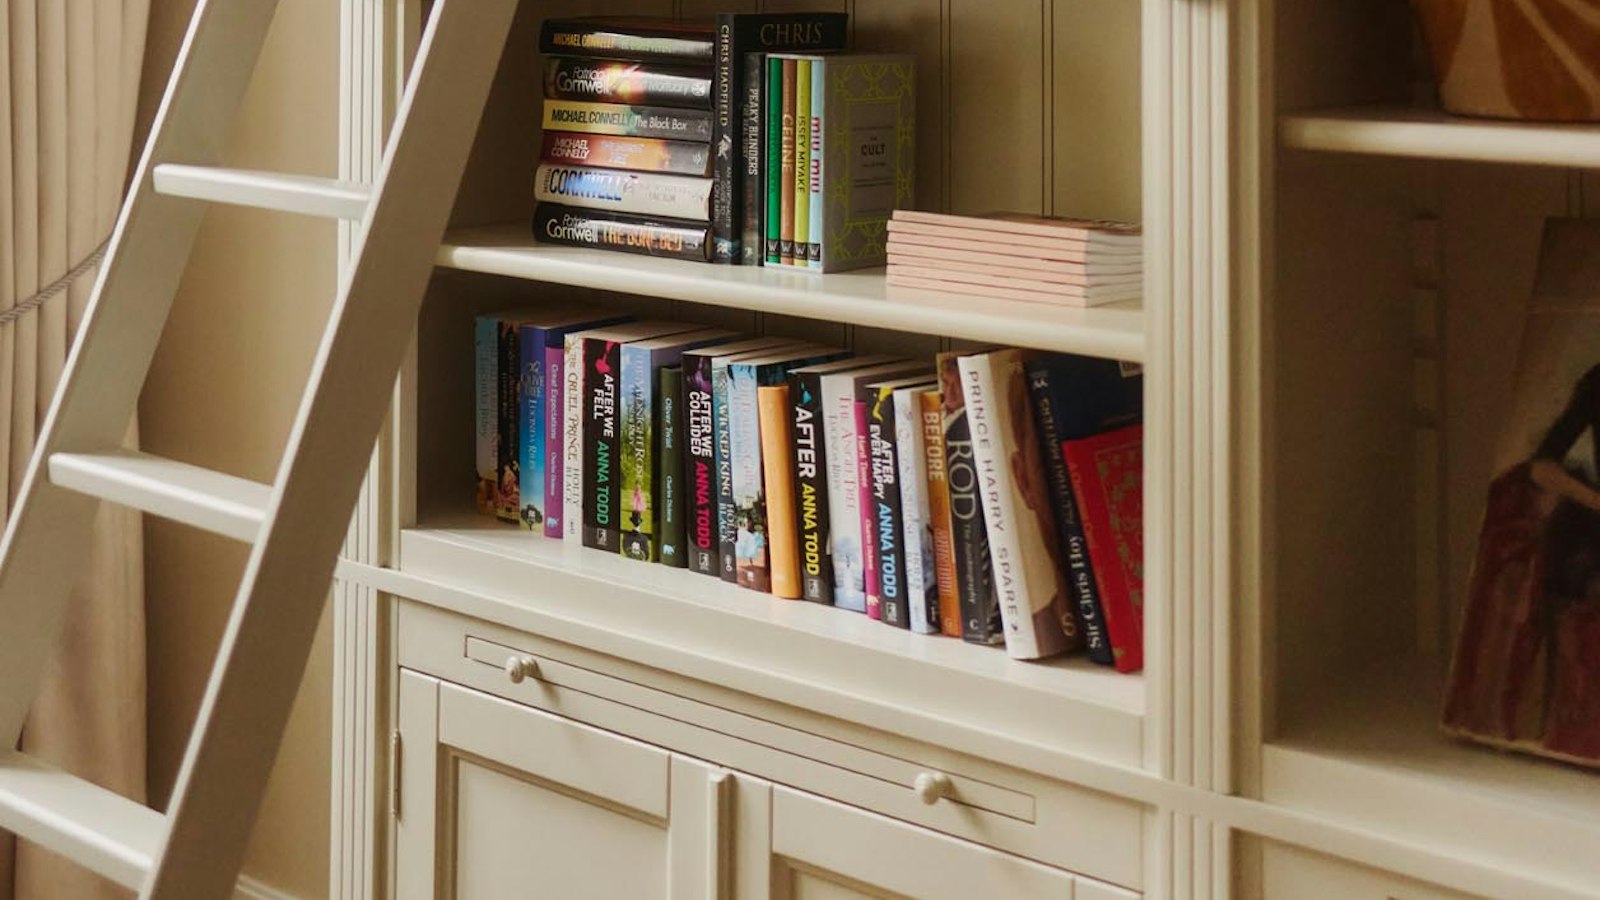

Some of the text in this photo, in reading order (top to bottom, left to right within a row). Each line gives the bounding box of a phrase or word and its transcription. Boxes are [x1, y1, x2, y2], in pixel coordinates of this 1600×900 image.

[760, 22, 823, 46] CHRIS
[556, 71, 611, 95] Cornwell
[719, 24, 730, 127] CHRIS HADFIELD
[552, 110, 632, 126] MICHAEL CONNELLY
[634, 115, 687, 131] The Black Box
[748, 88, 759, 121] PEAKY
[551, 148, 591, 161] CONNELLY
[555, 137, 589, 150] MICHAEL
[748, 125, 759, 176] BLINDERS
[797, 116, 807, 193] ISSEY MIYAKE
[810, 116, 821, 193] miu miu
[860, 144, 886, 156] CULT
[546, 219, 598, 243] Cornwell
[603, 228, 683, 252] THE BONE BED
[549, 363, 558, 440] Great Expectations
[568, 372, 578, 412] CRUEL
[593, 388, 604, 420] FELL
[603, 373, 614, 438] AFTER WE
[567, 414, 579, 461] PRINCE
[664, 397, 673, 449] Oliver Twist
[689, 391, 701, 455] COLLIDED
[701, 391, 712, 457] AFTER WE
[795, 406, 815, 478] AFTER
[596, 440, 609, 483] ANNA
[718, 402, 731, 497] WICKED KING
[858, 435, 868, 487] Hard Times
[869, 424, 885, 500] EVER HAPPY
[881, 439, 894, 484] AFTER
[925, 412, 944, 482] BEFORE
[572, 468, 580, 506] HOLLY
[695, 461, 709, 505] ANNA
[947, 439, 977, 520] ROD
[968, 371, 1018, 617] PRINCE HARRY SPARE
[596, 486, 609, 525] TODD
[719, 503, 727, 545] BLACK
[725, 503, 736, 545] HOLLY
[801, 482, 817, 530] ANNA
[878, 503, 894, 551] ANNA
[696, 508, 710, 548] TODD
[804, 532, 820, 576] TODD
[1067, 535, 1084, 569] Hoy
[882, 554, 897, 598] TODD
[1075, 571, 1095, 620] Chris
[1087, 619, 1102, 649] Sir
